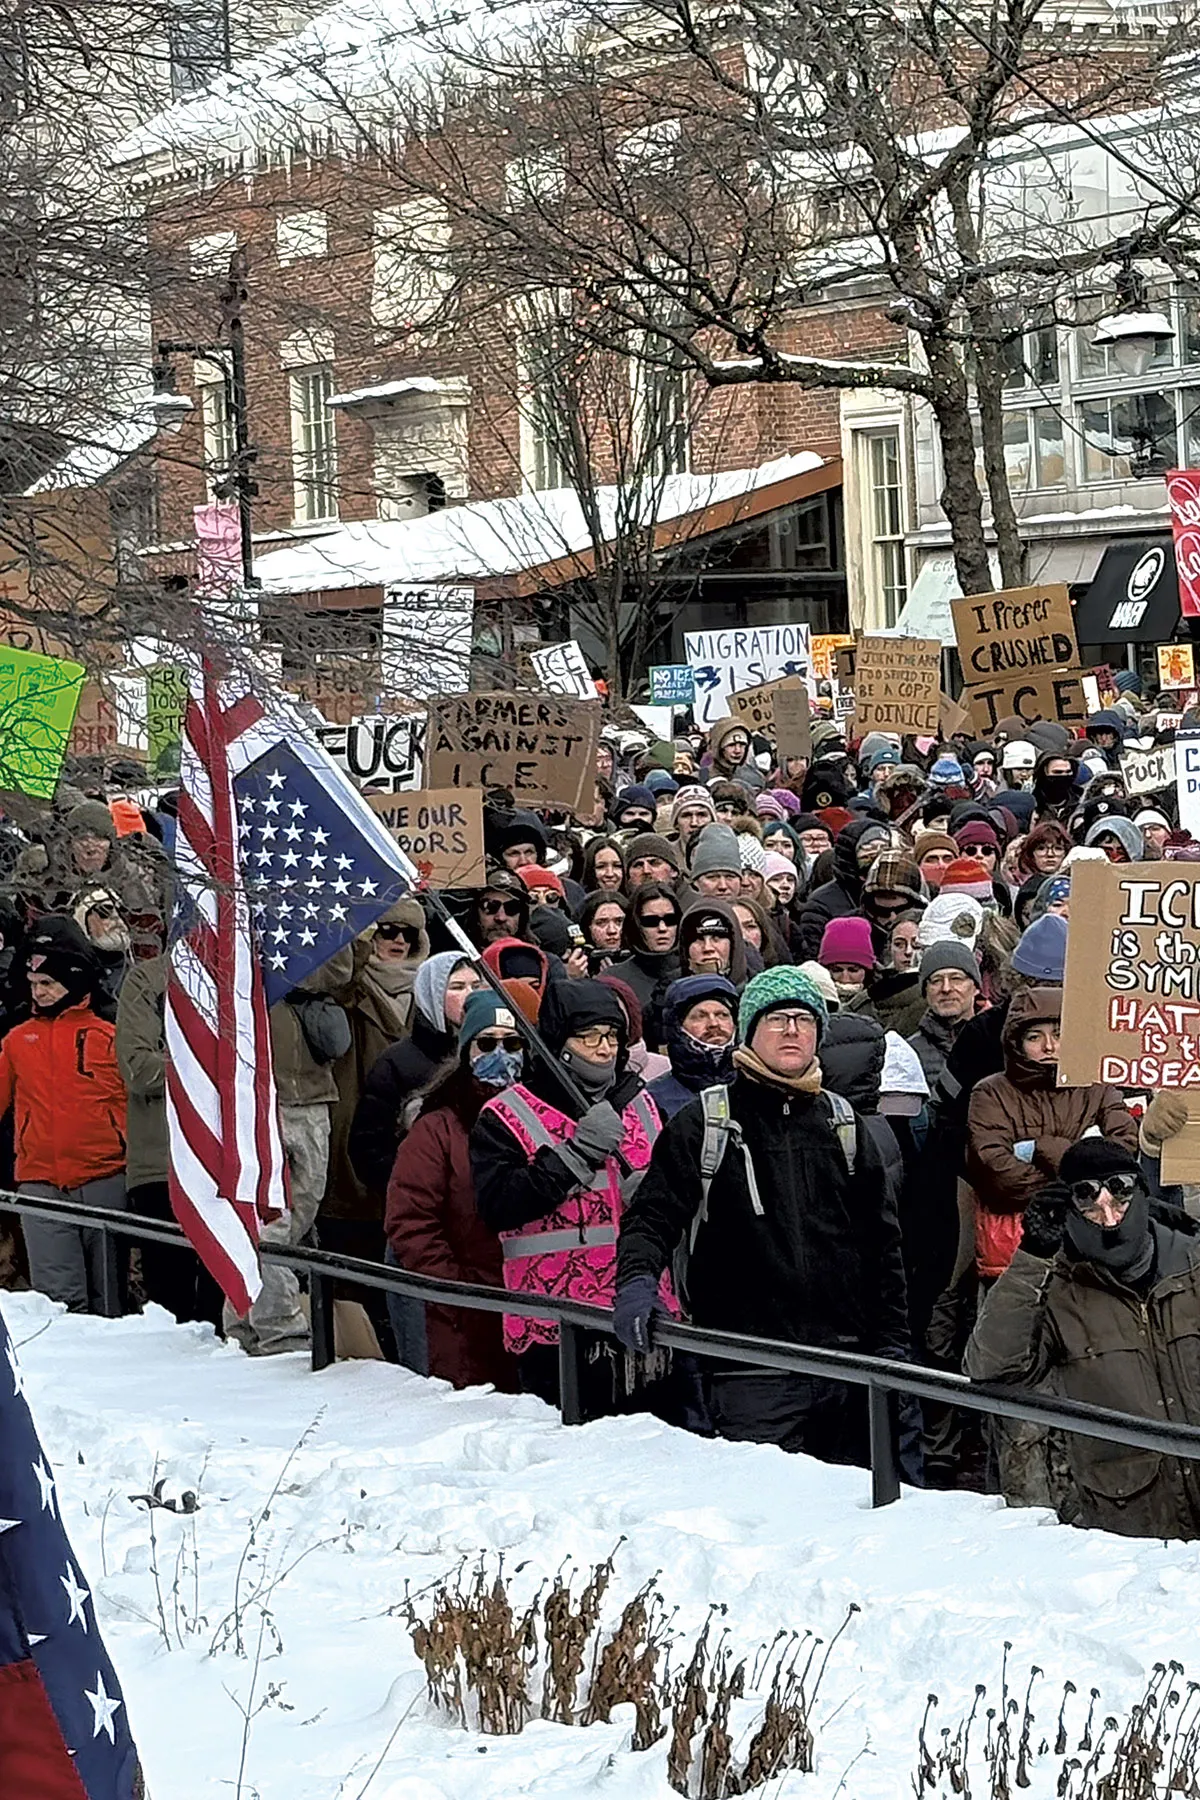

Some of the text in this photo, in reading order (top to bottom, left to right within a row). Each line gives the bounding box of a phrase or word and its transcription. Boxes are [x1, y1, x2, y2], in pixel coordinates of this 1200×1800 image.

[972, 598, 1052, 634] I Prefer
[685, 627, 809, 661] MIGRATION
[970, 633, 1073, 673] CRUSHED
[532, 643, 582, 680] ICE
[652, 669, 671, 682] NO
[857, 667, 883, 682] TOO
[920, 670, 936, 683] TO
[729, 662, 767, 693] IS
[860, 683, 932, 699] BE A COP?
[436, 698, 569, 728] FARMERS
[858, 702, 905, 724] JOIN
[315, 720, 428, 778] FUCK
[436, 726, 583, 758] AGAINST
[1124, 756, 1168, 788] FUCK
[376, 803, 468, 829] VE OUR
[1111, 928, 1140, 958] is
[1141, 1027, 1169, 1056] is
